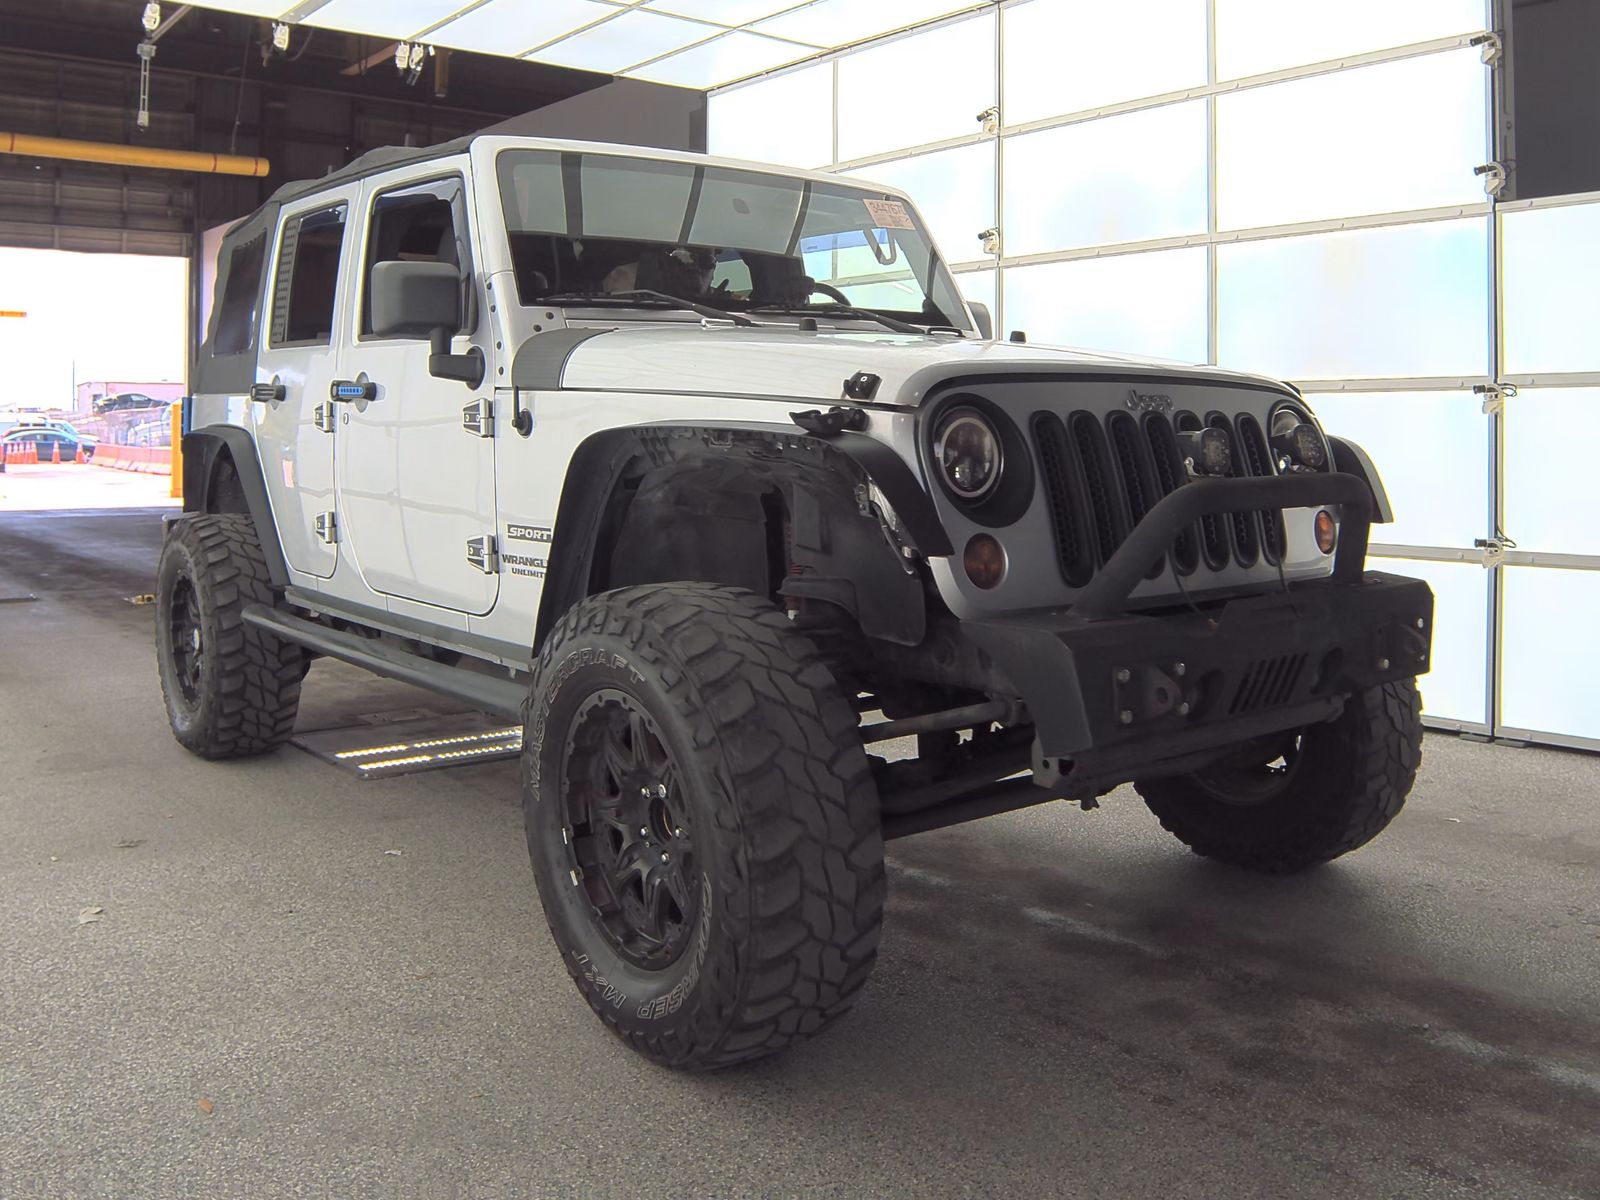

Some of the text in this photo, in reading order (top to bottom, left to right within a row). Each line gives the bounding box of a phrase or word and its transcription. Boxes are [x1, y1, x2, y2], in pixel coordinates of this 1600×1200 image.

[1125, 390, 1174, 413] Jeep
[508, 527, 551, 540] SPORT
[529, 647, 646, 803] MASTERCRAFT
[571, 950, 627, 1009] MXT
